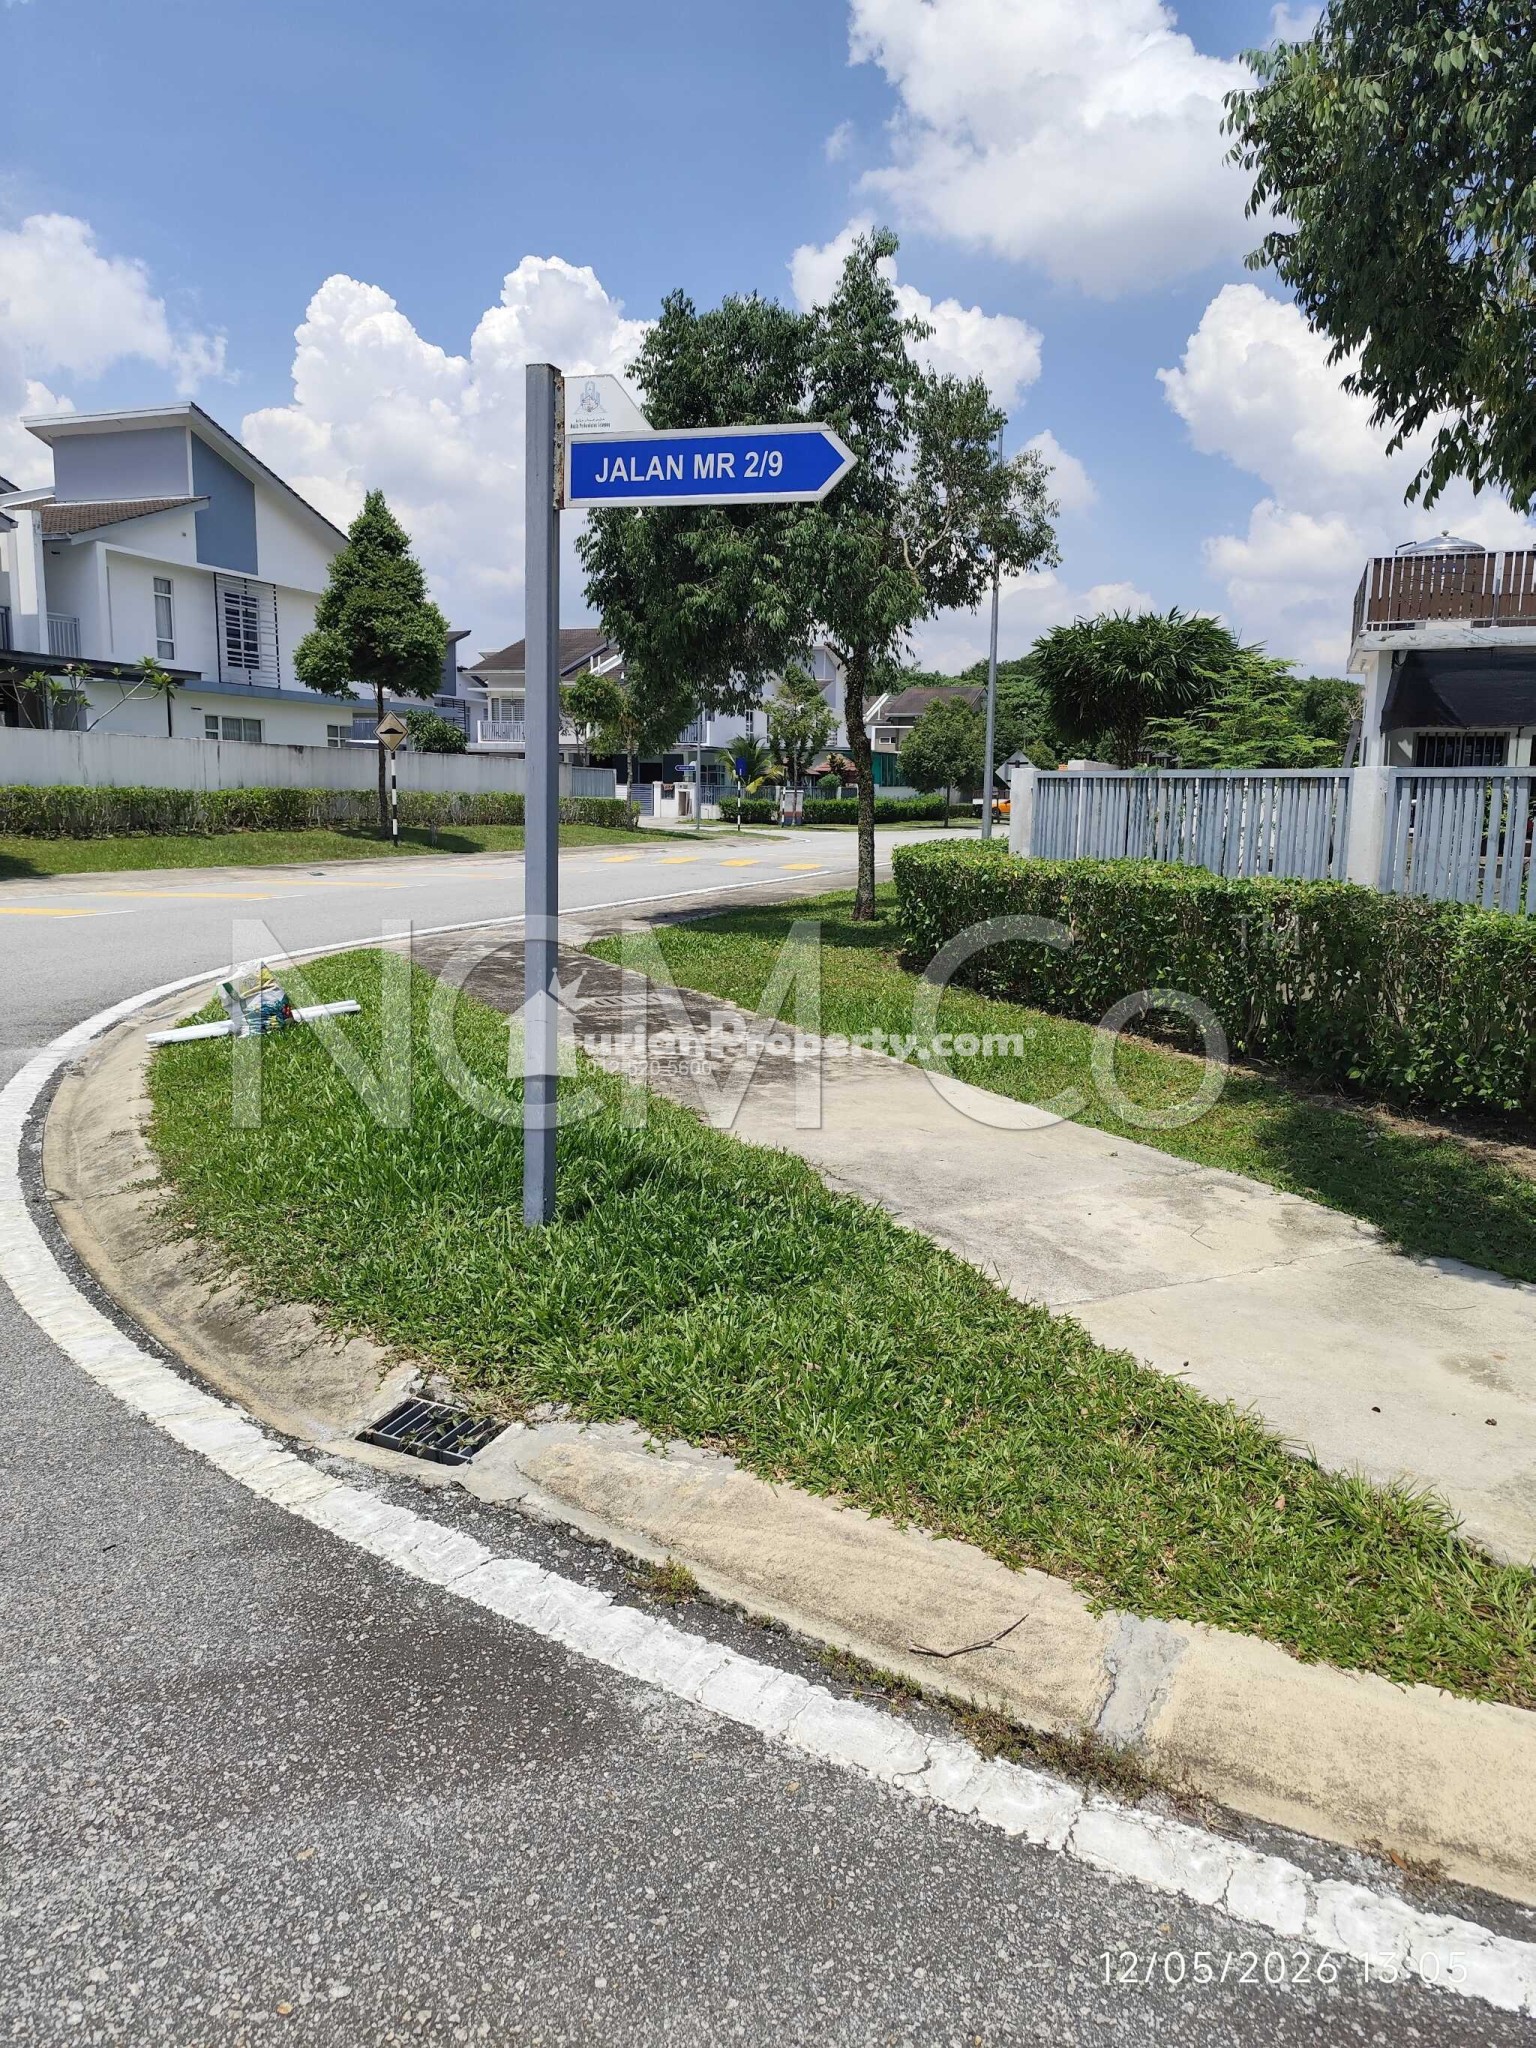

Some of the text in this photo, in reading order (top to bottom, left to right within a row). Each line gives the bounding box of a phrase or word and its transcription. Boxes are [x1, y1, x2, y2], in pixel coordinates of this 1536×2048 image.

[595, 450, 783, 483] JALAN MR 2/9
